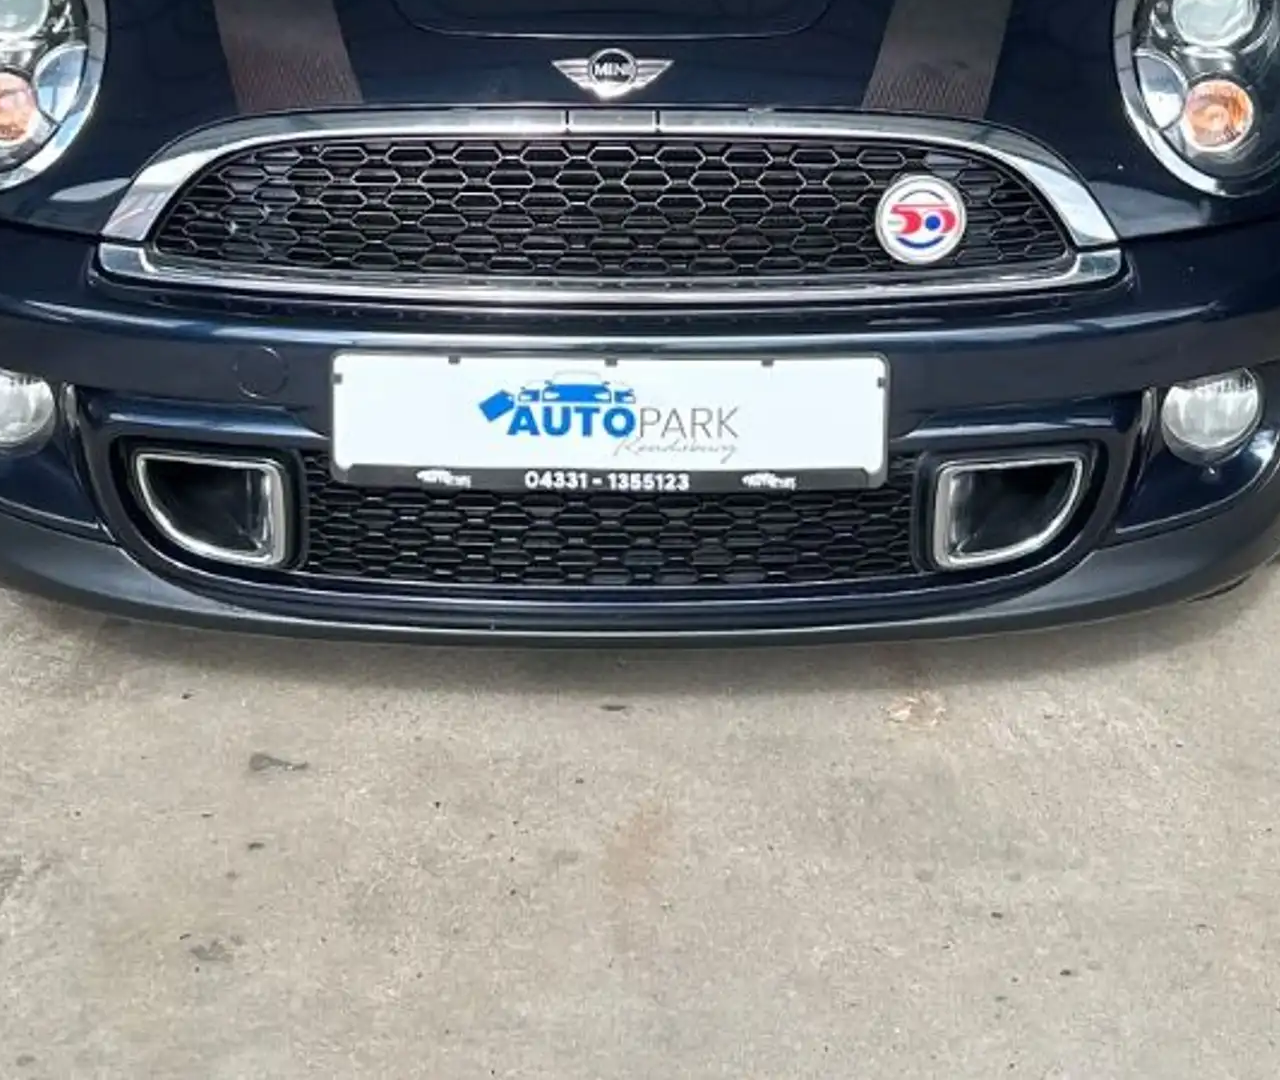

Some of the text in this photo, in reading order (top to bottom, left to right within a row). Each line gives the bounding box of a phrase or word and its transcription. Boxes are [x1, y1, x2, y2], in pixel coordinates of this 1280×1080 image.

[507, 406, 739, 438] AUTOPARK
[524, 471, 588, 489] 04331
[607, 473, 689, 491] 1355123
